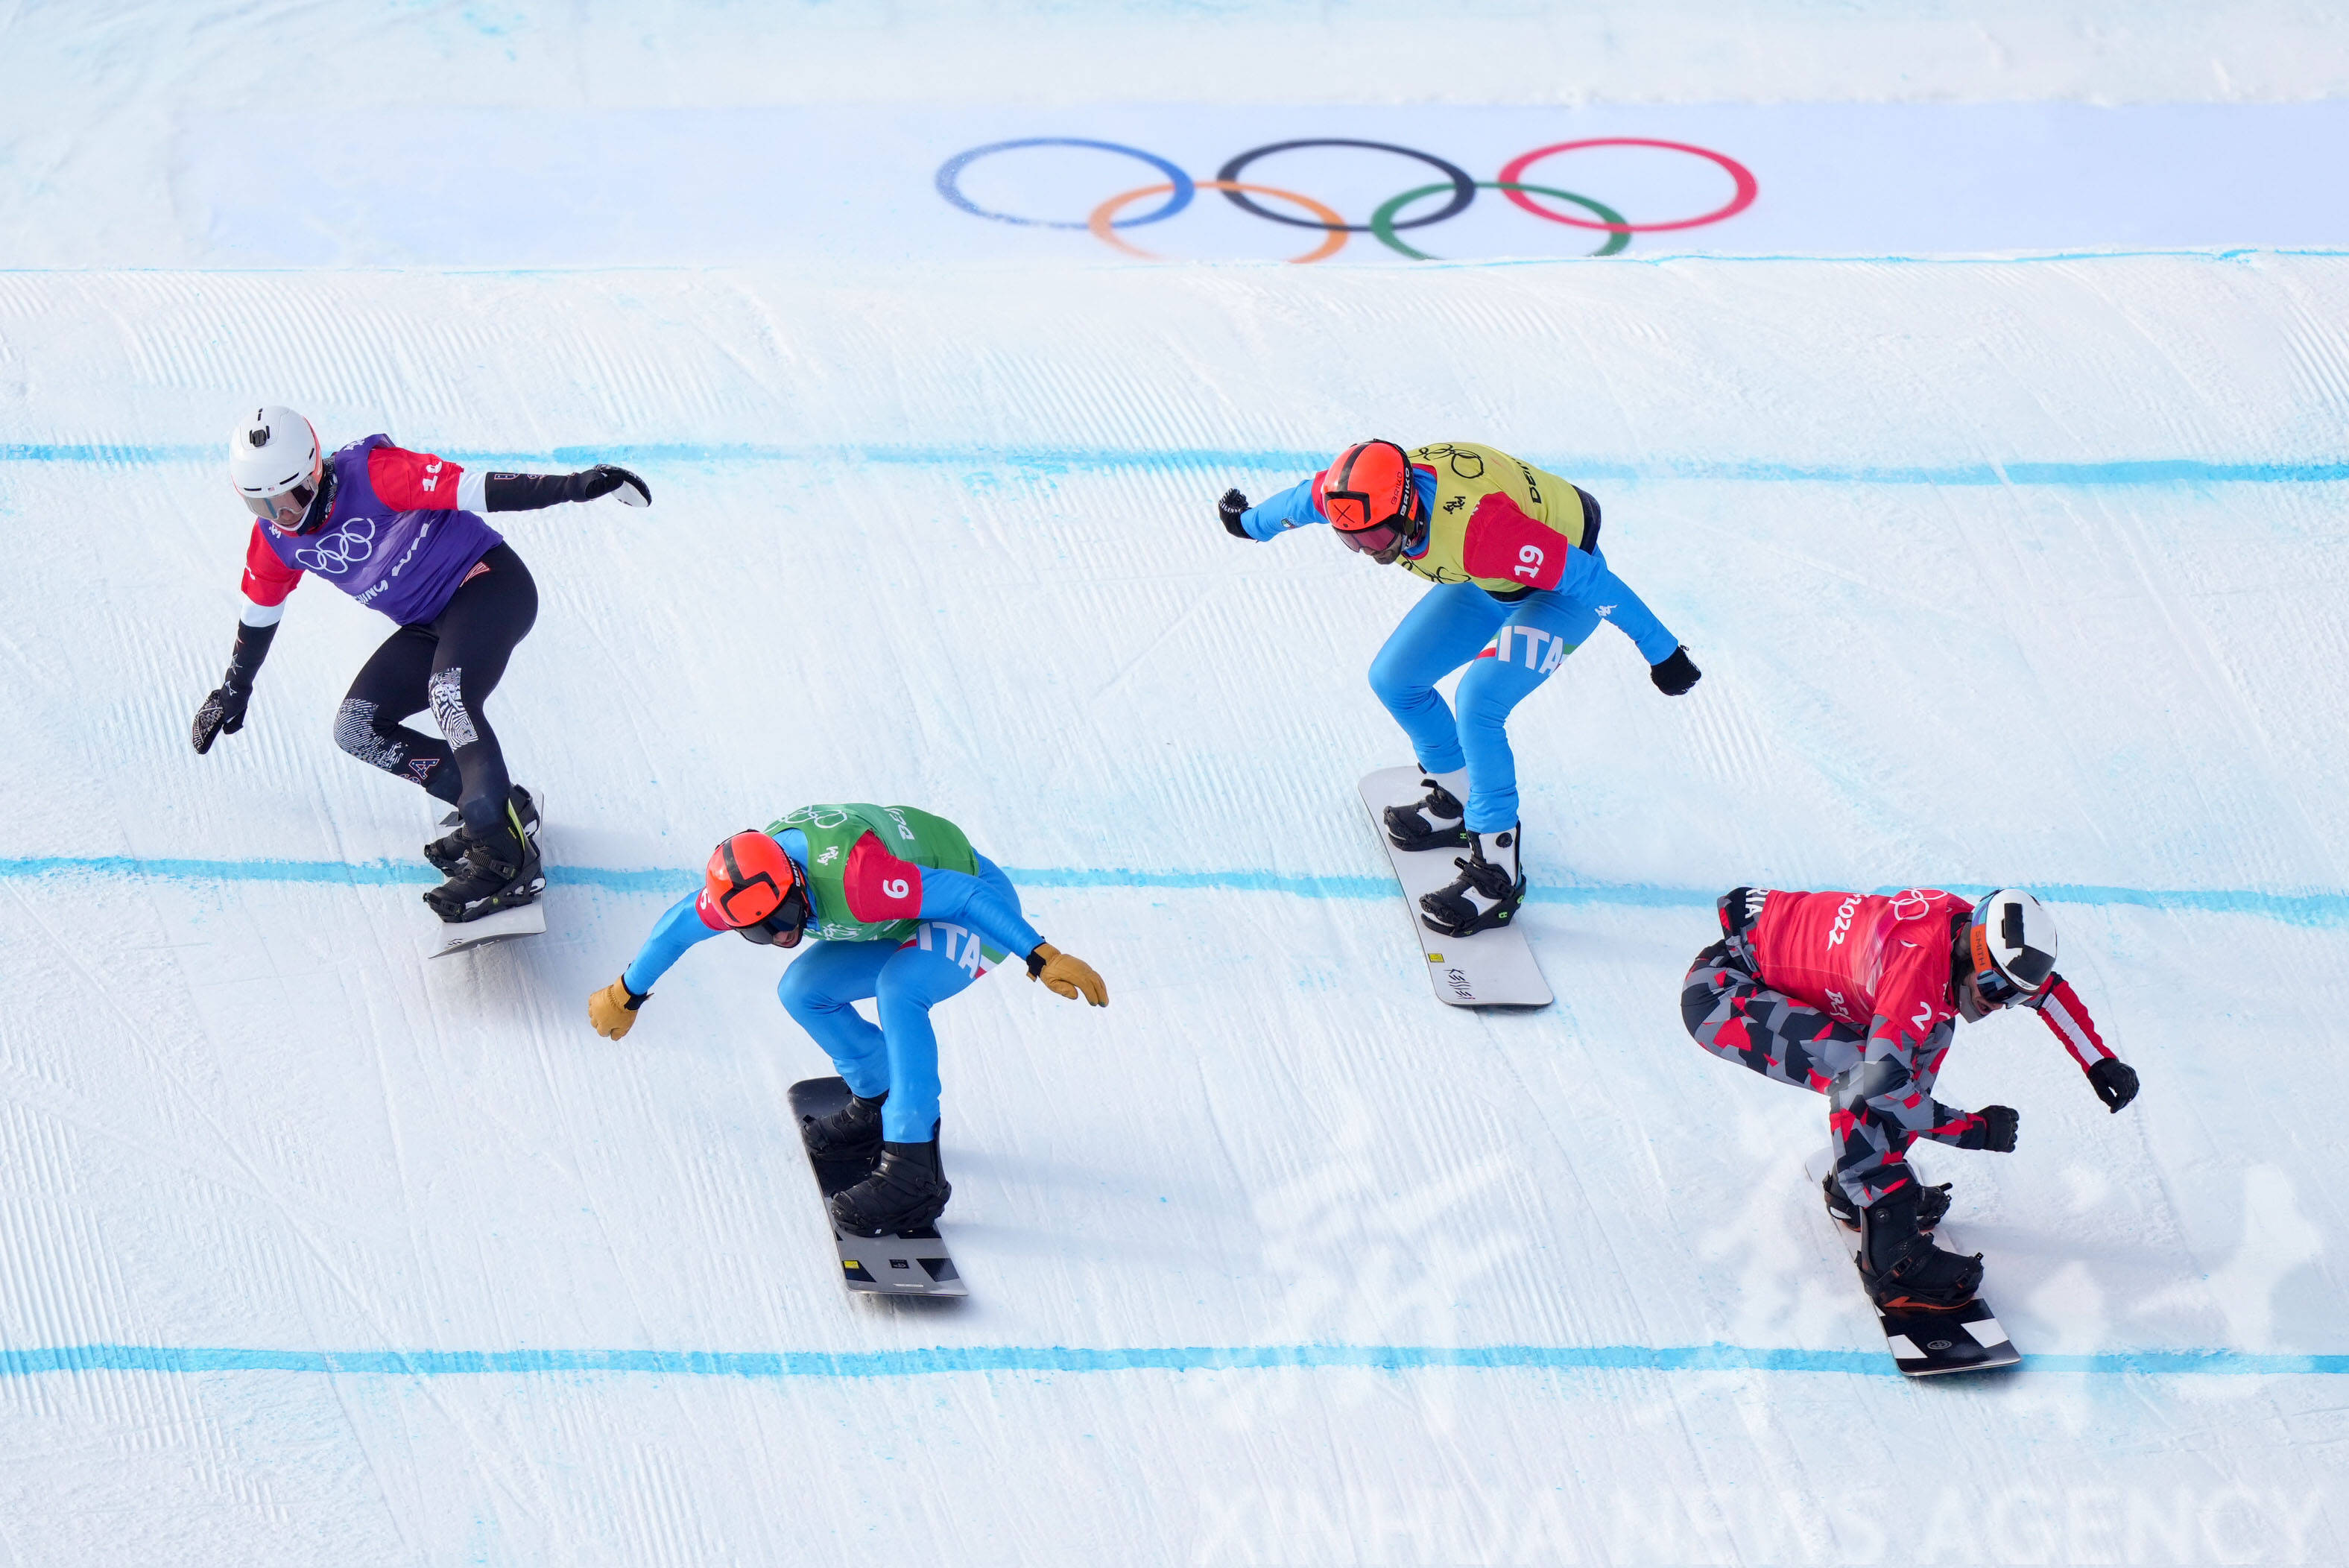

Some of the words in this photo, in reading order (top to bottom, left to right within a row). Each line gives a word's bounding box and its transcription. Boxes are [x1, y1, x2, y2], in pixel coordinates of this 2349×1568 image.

[1400, 467, 1411, 516] BRIKO
[1514, 545, 1544, 578] 19
[1498, 625, 1564, 675] ITA
[882, 879, 909, 899] 6
[1827, 897, 1862, 951] 2022
[1973, 930, 1986, 967] SMITH
[919, 922, 981, 979] ITA
